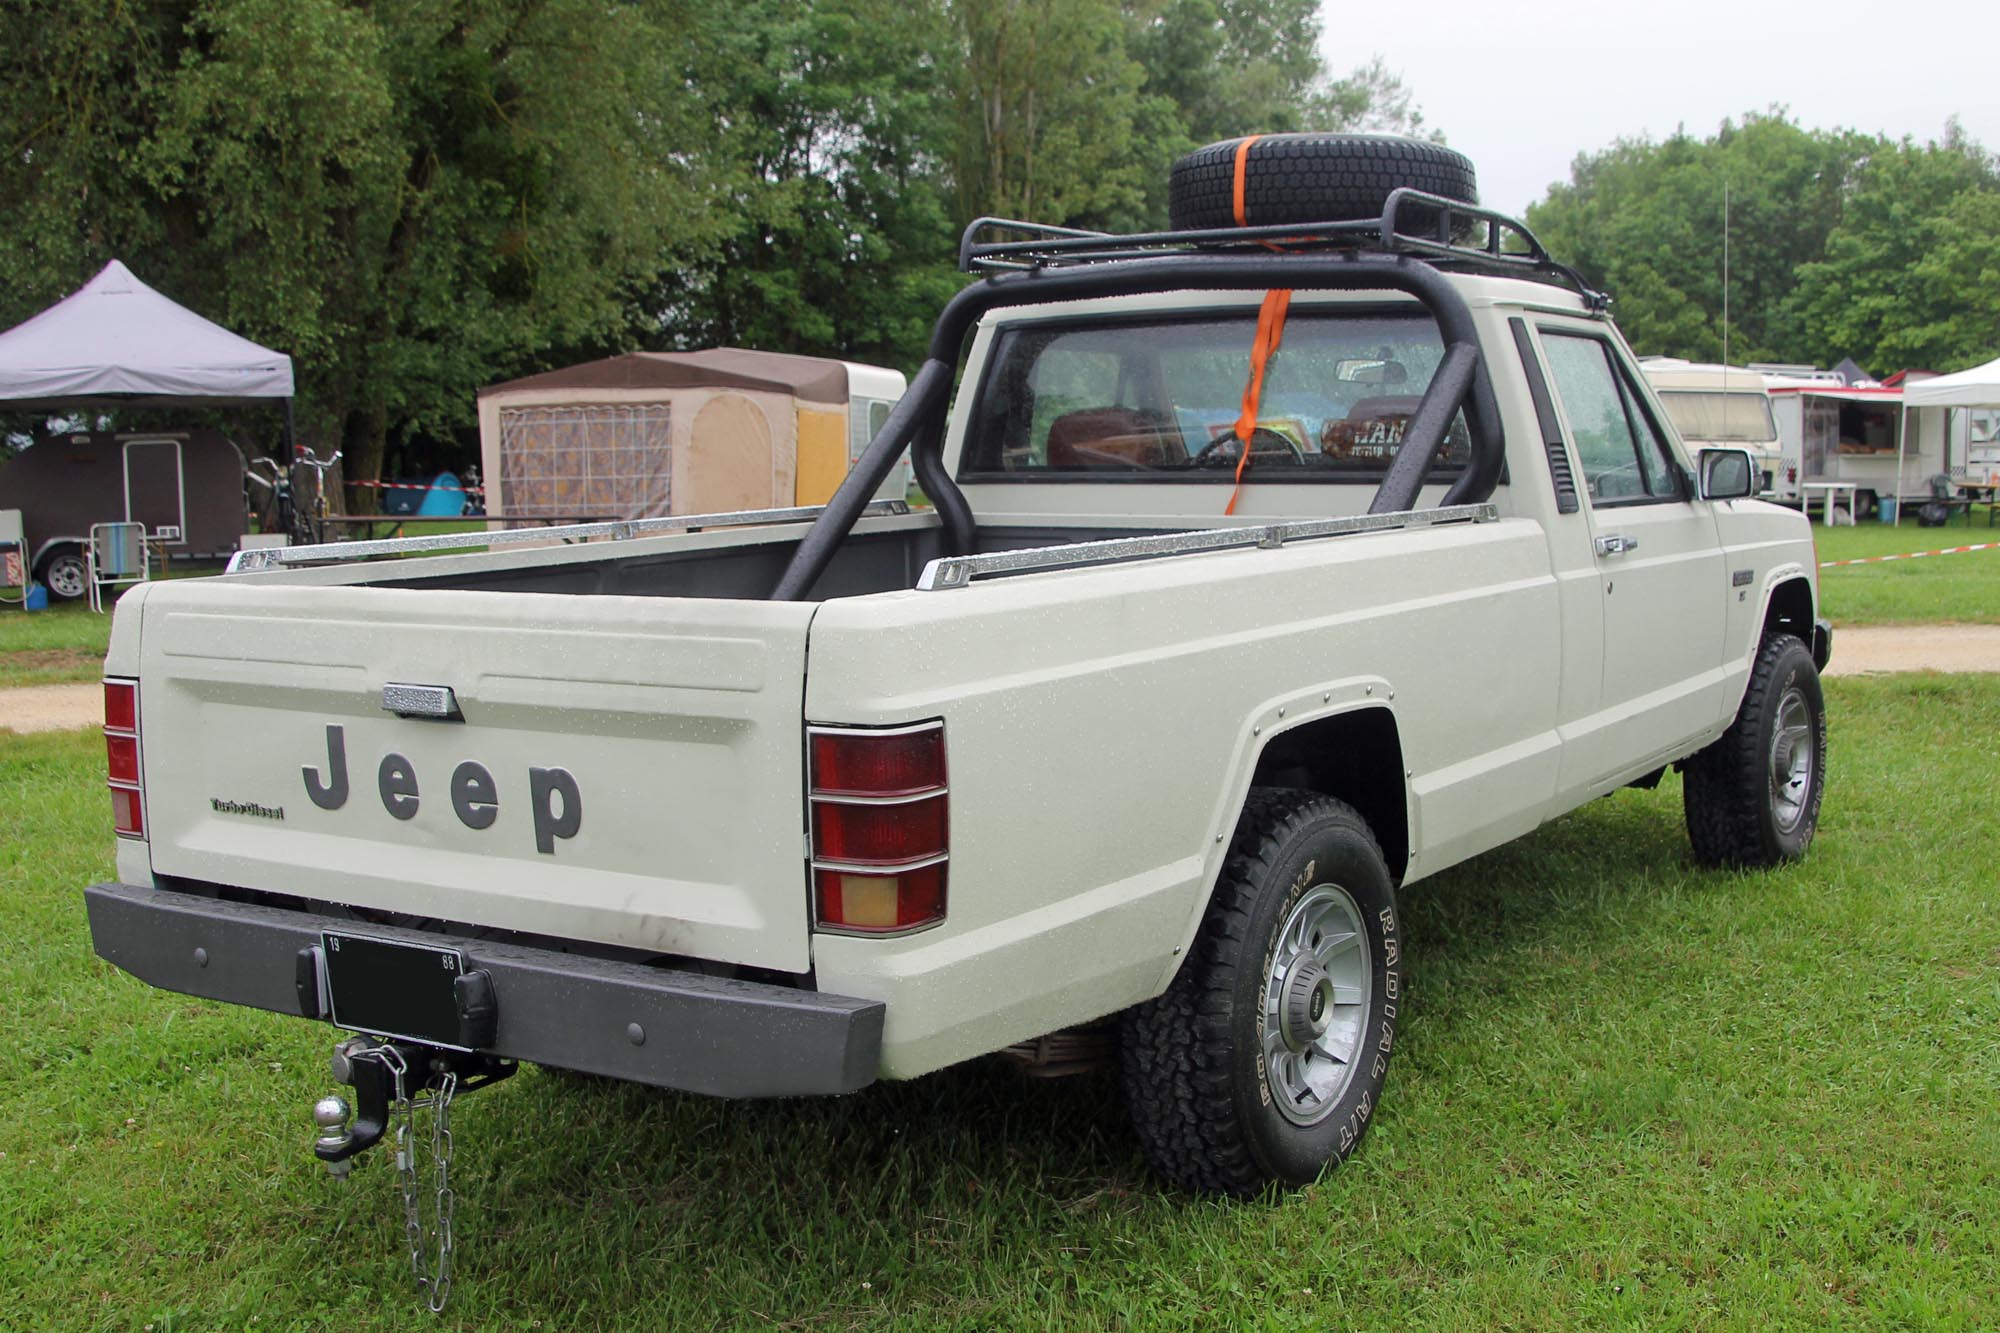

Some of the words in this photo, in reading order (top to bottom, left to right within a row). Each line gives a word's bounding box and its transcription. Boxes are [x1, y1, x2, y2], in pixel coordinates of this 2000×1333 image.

[302, 722, 583, 855] Jeep
[329, 936, 340, 952] 19
[442, 954, 455, 970] 88
[1370, 905, 1399, 1080] RADIAL
